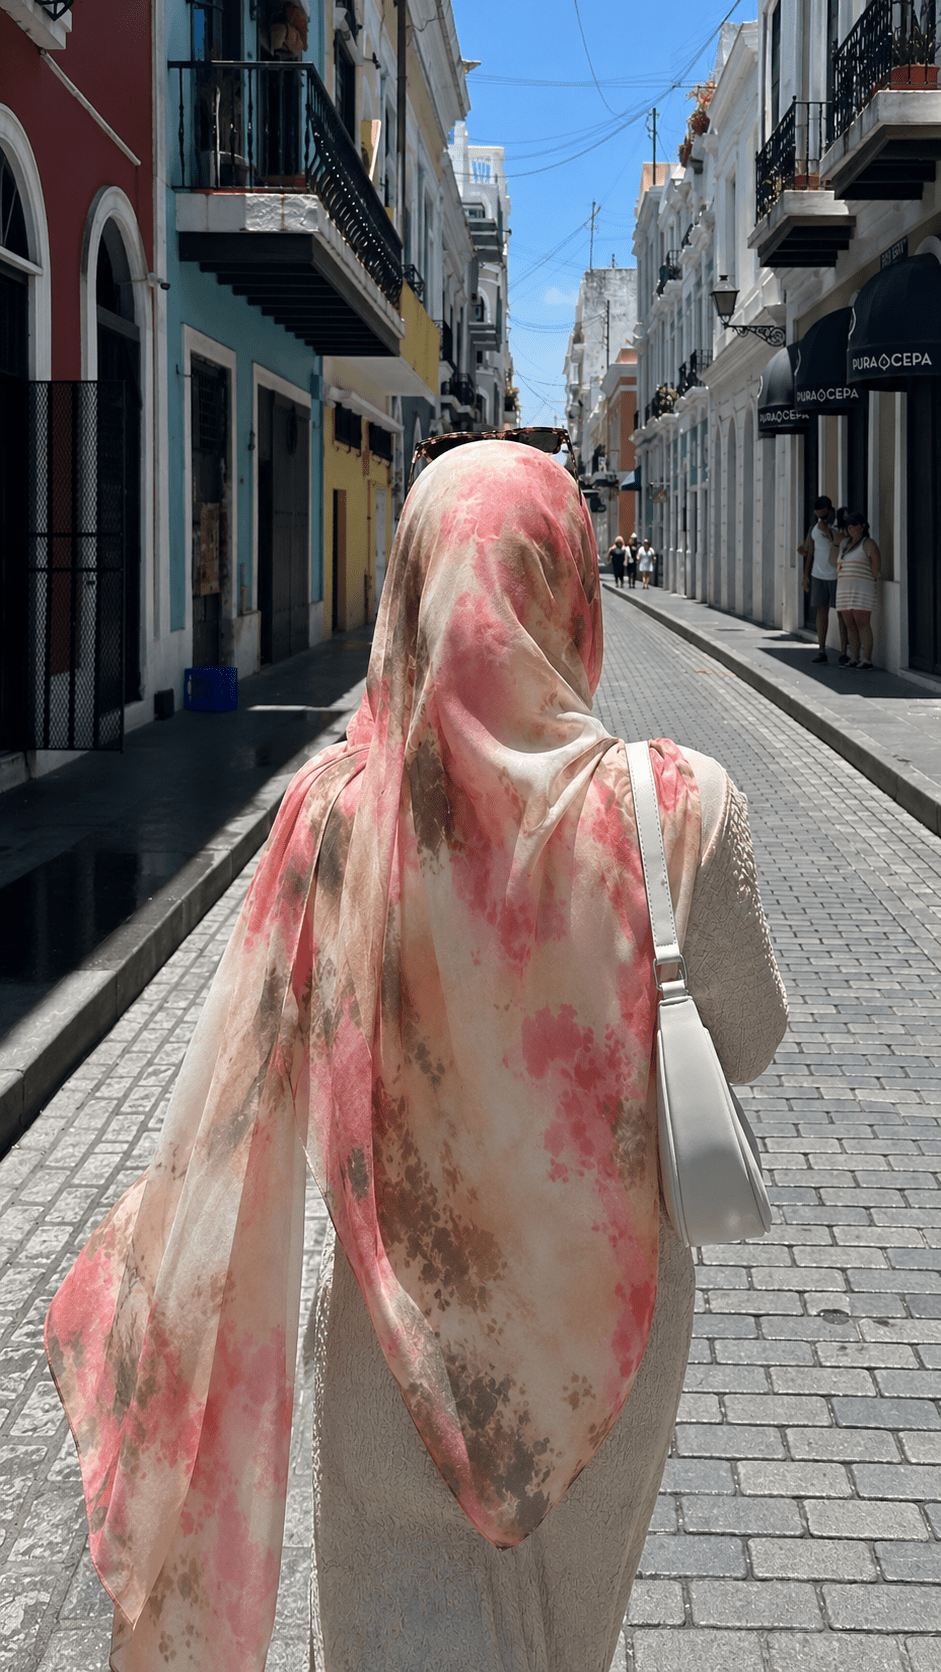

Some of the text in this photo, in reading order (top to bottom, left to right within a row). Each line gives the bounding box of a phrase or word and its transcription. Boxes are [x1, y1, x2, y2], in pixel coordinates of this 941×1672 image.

[852, 352, 933, 371] PURA CEPA
[796, 387, 859, 402] PURA CEPA
